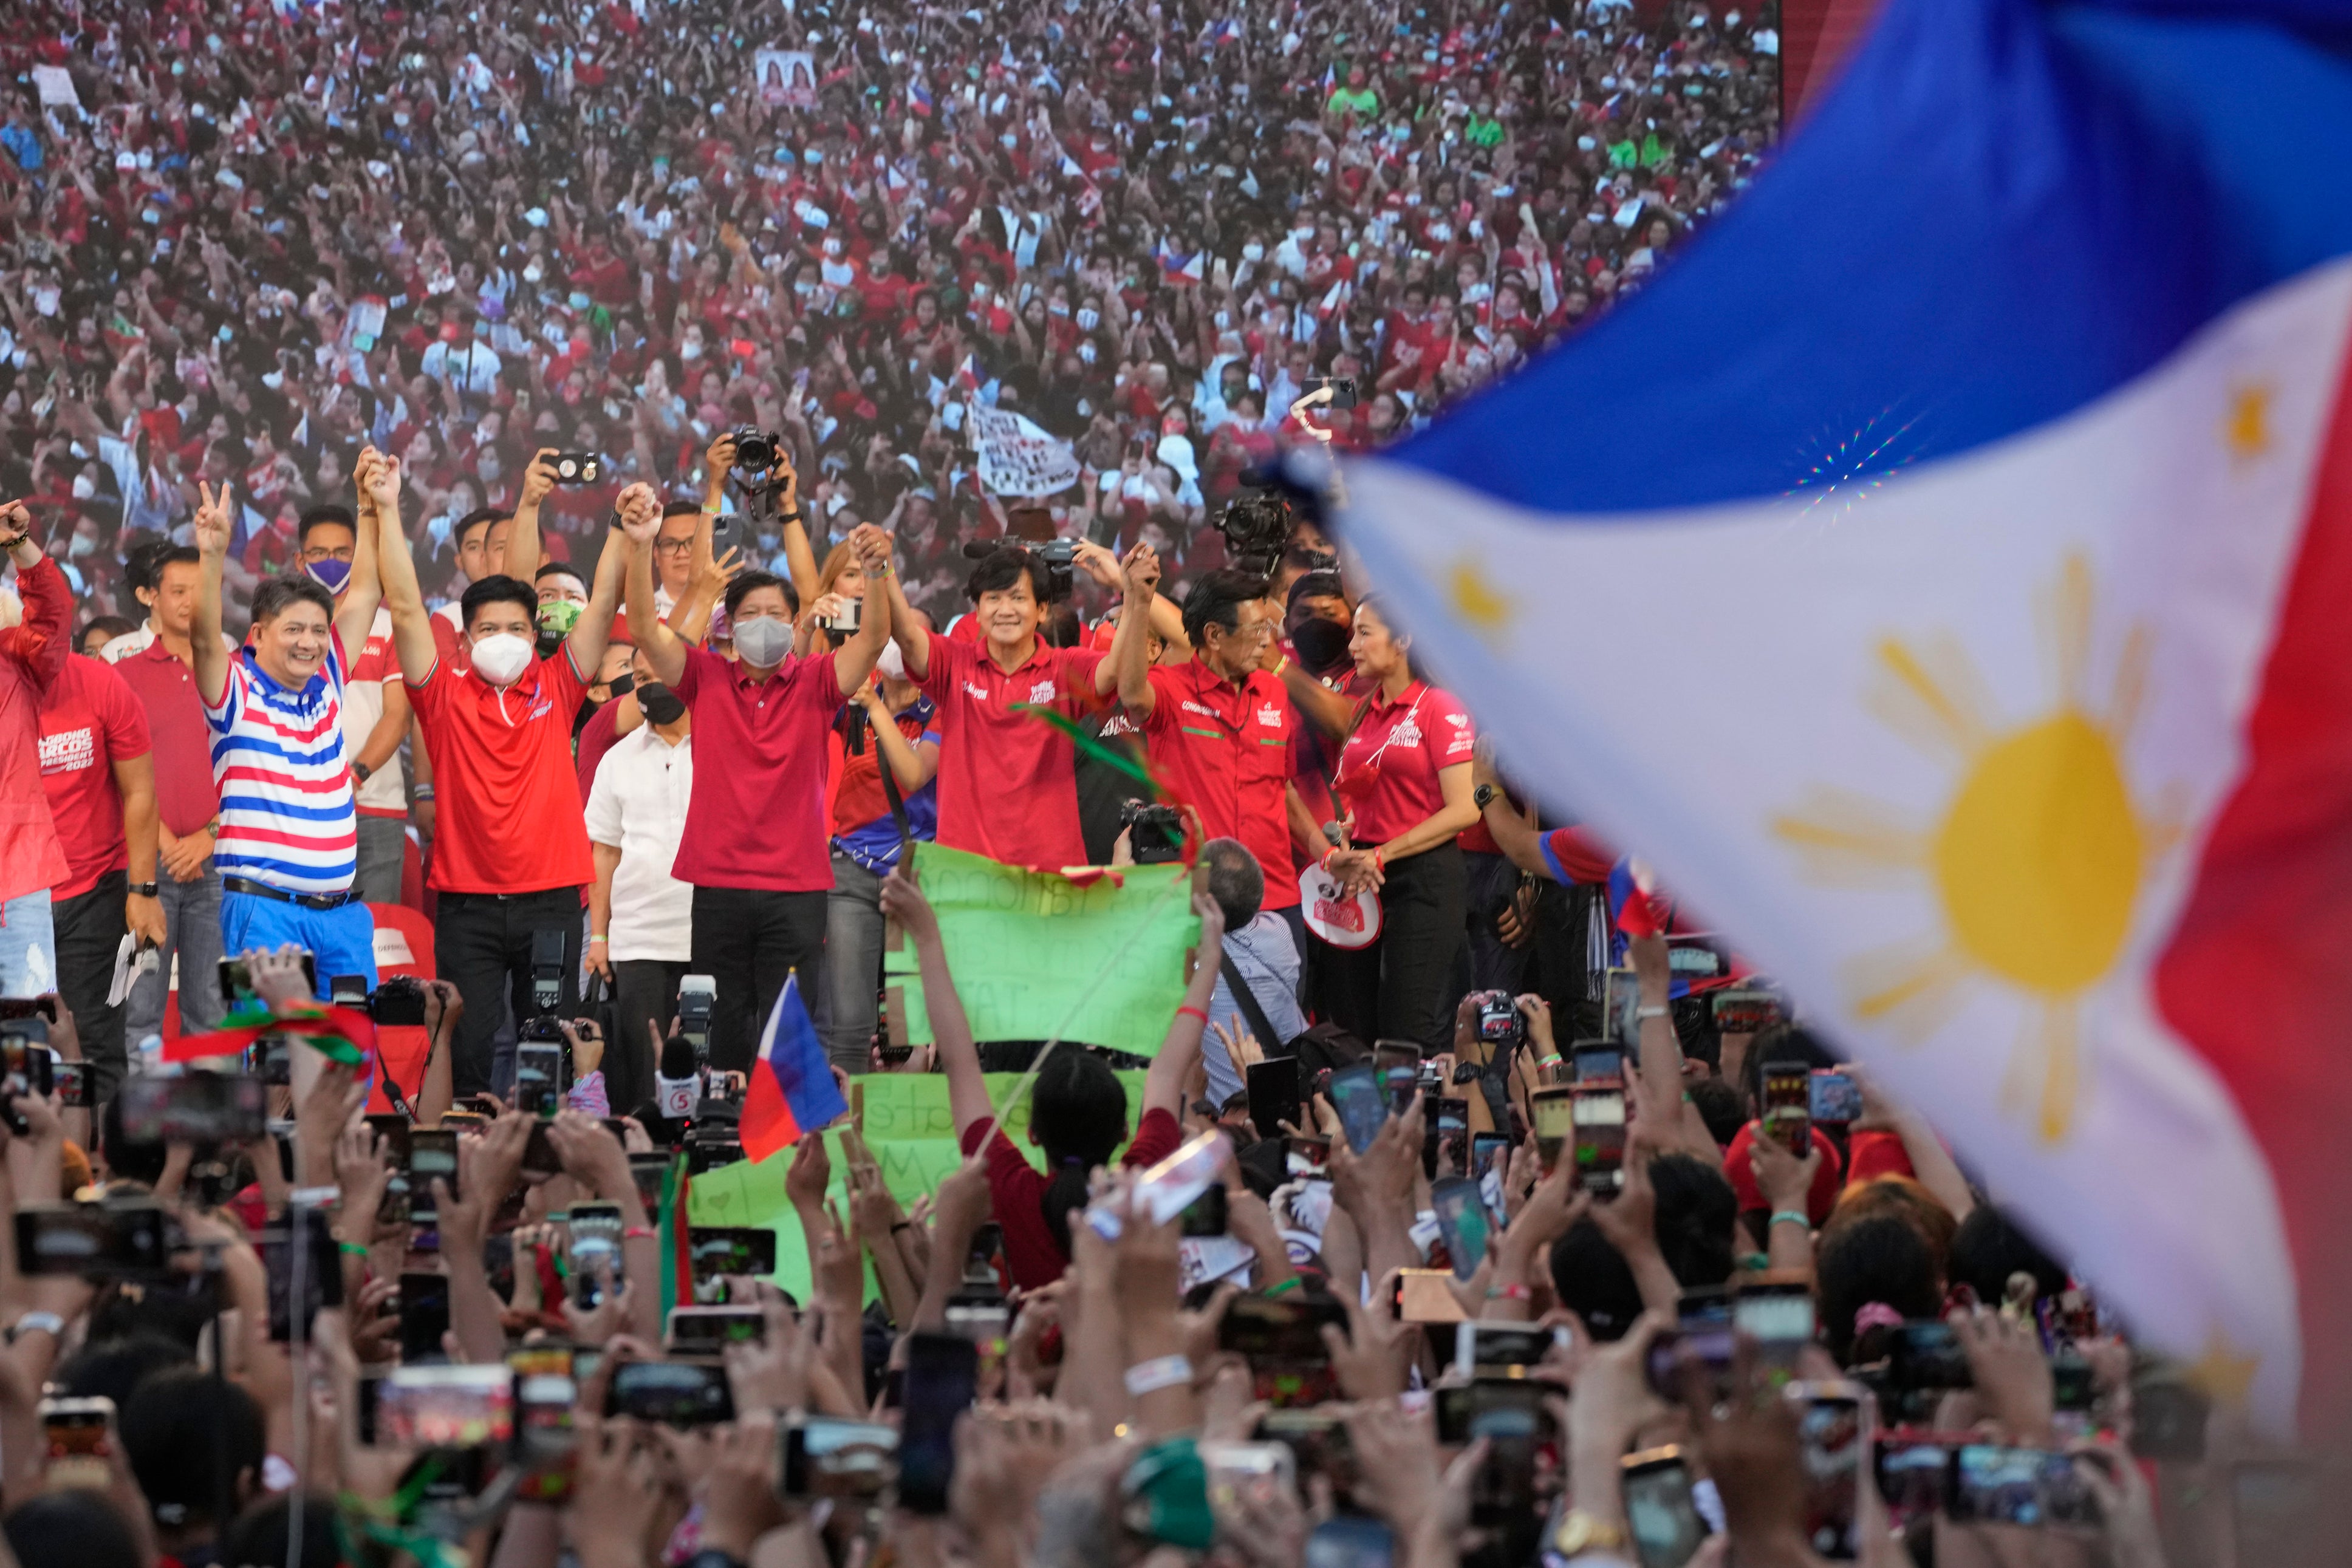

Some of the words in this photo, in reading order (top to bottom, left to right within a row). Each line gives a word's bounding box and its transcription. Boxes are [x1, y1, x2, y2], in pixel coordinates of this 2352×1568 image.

[38, 726, 91, 747] GBONG
[66, 757, 94, 771] 2022
[677, 1094, 688, 1109] 5
